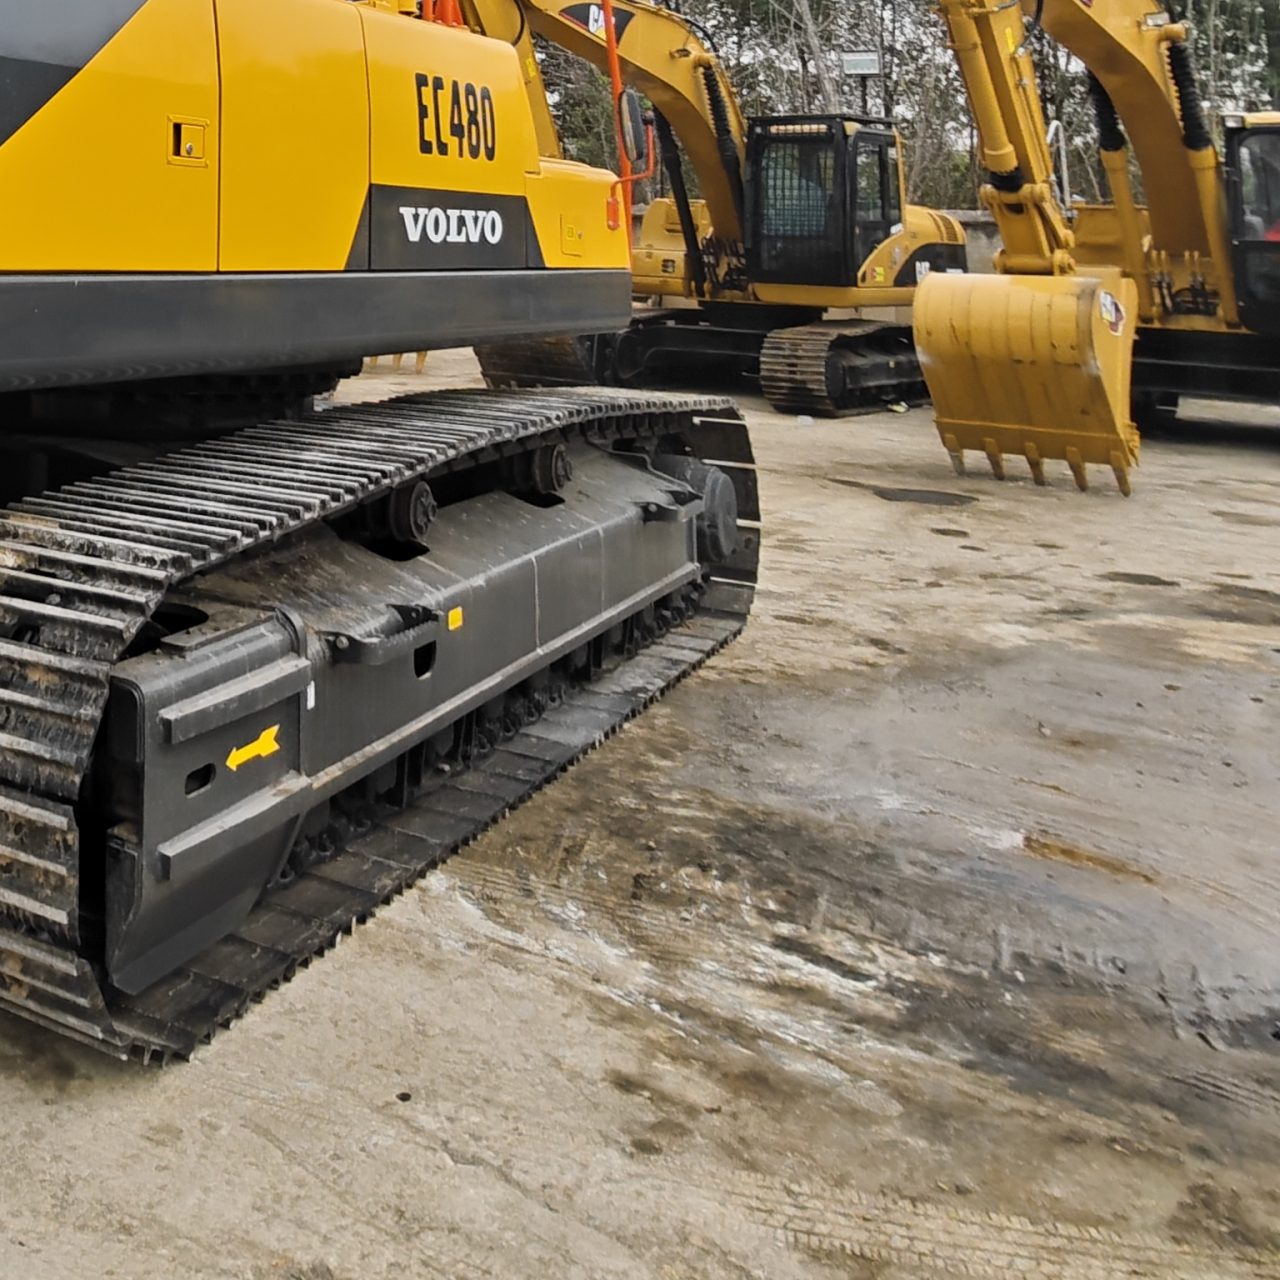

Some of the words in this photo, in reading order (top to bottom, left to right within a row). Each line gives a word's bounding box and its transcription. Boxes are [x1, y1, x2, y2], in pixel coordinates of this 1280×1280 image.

[589, 4, 616, 38] CA
[415, 72, 496, 161] EC480
[399, 206, 503, 245] VOLVO
